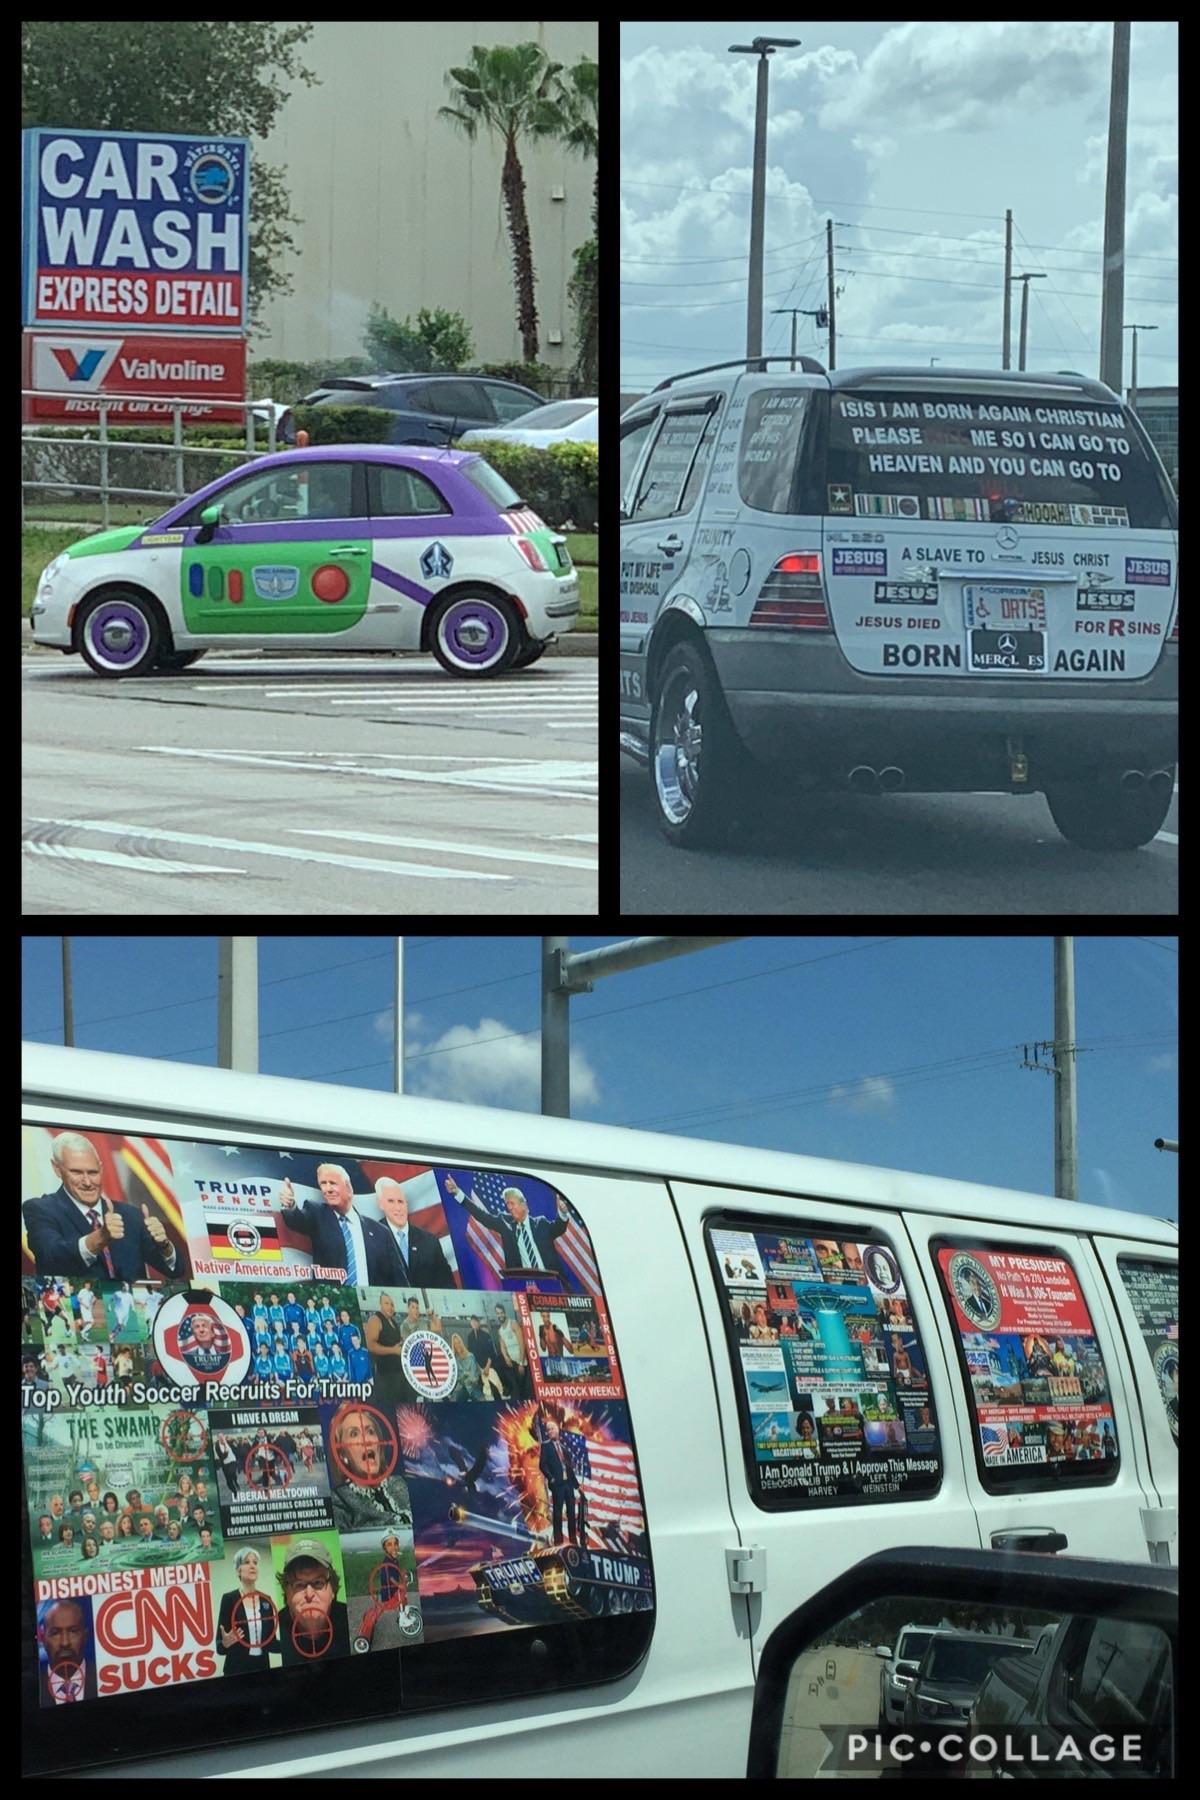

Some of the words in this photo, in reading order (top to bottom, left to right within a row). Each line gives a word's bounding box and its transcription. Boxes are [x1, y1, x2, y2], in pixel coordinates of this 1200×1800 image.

[40, 139, 181, 201] CAR
[41, 206, 241, 271] WASH
[38, 276, 148, 315] EXPRESS
[155, 280, 239, 317] DETAIL
[119, 358, 225, 382] Valvoline
[840, 401, 876, 418] ISIS
[880, 402, 888, 418] I
[892, 403, 919, 419] AM
[923, 404, 973, 421] BORN
[978, 405, 1032, 424] AGAIN
[1035, 408, 1126, 430] CHRISTIAN
[852, 427, 922, 446] PLEASE
[970, 429, 998, 448] ME
[1002, 430, 1026, 449] SO
[1029, 432, 1036, 449] I
[1040, 433, 1076, 452] CAN
[1078, 435, 1101, 453] GO
[1106, 437, 1130, 456] TO
[869, 454, 944, 474] HEAVEN
[948, 456, 985, 475] AND
[989, 457, 1025, 476] YOU
[1031, 458, 1065, 478] CAN
[1069, 461, 1094, 480] GO
[1097, 462, 1122, 482] TO
[1024, 503, 1066, 523] HOOAH
[834, 550, 885, 566] JESUS
[901, 547, 912, 561] A
[916, 547, 961, 563] SLAVE
[966, 549, 985, 563] TO
[1031, 551, 1065, 566] JESUS
[1073, 552, 1110, 567] CHRIST
[1127, 559, 1169, 576] JESUS
[875, 585, 938, 600] JESUS
[1078, 592, 1134, 607] JESUS
[855, 616, 902, 629] JESUS
[907, 616, 941, 630] DIED
[1075, 620, 1105, 634] FOR
[1108, 619, 1126, 637] R
[1128, 621, 1161, 635] SINS
[883, 643, 961, 668] BORN
[1054, 648, 1126, 672] AGAIN
[194, 1179, 272, 1197] TRUMP
[200, 1194, 272, 1208] PENCE
[194, 1260, 232, 1275] Native
[235, 1261, 292, 1278] Americans
[294, 1265, 309, 1278] For
[312, 1265, 348, 1285] Trump
[988, 1255, 1006, 1268] MY
[1007, 1257, 1067, 1273] PRESIDENT
[518, 1294, 542, 1383] SEMINOLE
[600, 1313, 618, 1366] TRIBE
[21, 1386, 61, 1412] Top
[68, 1383, 126, 1406] Youth
[132, 1382, 200, 1404] Soccer
[205, 1380, 280, 1401] Recruits
[285, 1379, 313, 1400] For
[320, 1379, 374, 1401] Trump
[538, 1386, 563, 1397] HARD
[563, 1386, 588, 1397] ROCK
[588, 1385, 621, 1396] WEEKLY
[66, 1417, 99, 1440] THE
[104, 1415, 162, 1439] SWAMP
[231, 1413, 236, 1425] I
[236, 1412, 261, 1426] HAVE
[261, 1412, 268, 1424] A
[268, 1411, 300, 1424] DREAM
[985, 1455, 999, 1466] MADE
[1006, 1447, 1043, 1463] AMERICA
[759, 1465, 764, 1480] I
[764, 1464, 780, 1479] Am
[781, 1462, 813, 1479] Donald
[814, 1461, 841, 1479] Trump
[842, 1461, 850, 1475] &
[850, 1461, 854, 1475] I
[855, 1460, 888, 1477] Approve
[887, 1458, 905, 1473] This
[906, 1457, 938, 1474] Message
[231, 1488, 268, 1503] LIBERAL
[269, 1486, 319, 1500] MELTDOWN!
[808, 1485, 839, 1497] HARVEY
[862, 1483, 900, 1495] WEINSTEIN
[258, 1503, 266, 1513] OF
[226, 1526, 249, 1537] ESCAPE
[485, 1557, 536, 1580] TRUMP
[590, 1553, 641, 1586] TRUMP
[38, 1570, 145, 1600] DISHONEST
[149, 1562, 207, 1589] MEDIA
[95, 1580, 215, 1660] CNN
[98, 1649, 217, 1695] SUCKS
